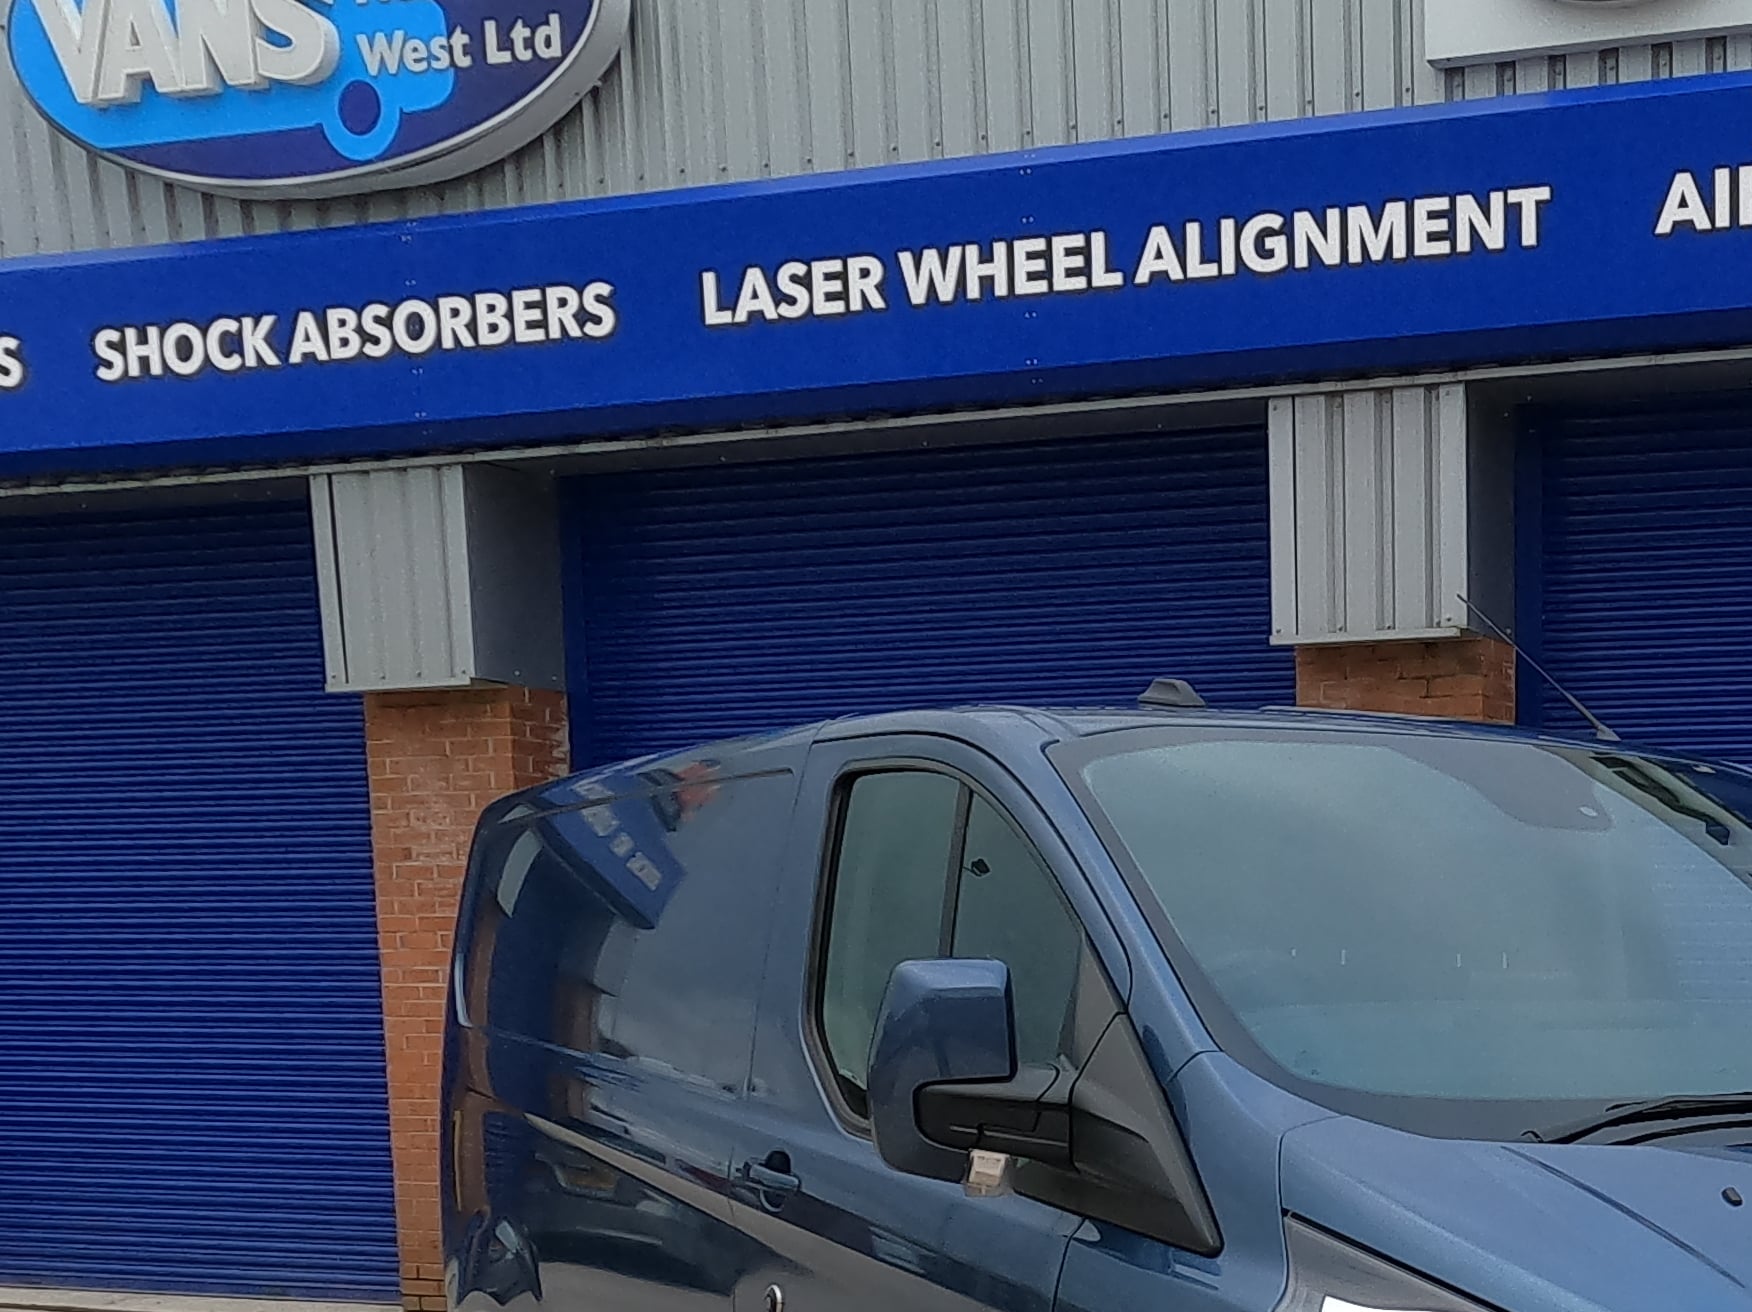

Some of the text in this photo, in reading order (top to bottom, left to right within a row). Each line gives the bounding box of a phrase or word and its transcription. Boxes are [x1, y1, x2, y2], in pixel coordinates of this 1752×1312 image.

[32, 0, 332, 105] VANS
[359, 13, 563, 76] West Ltd
[702, 185, 1551, 326] LASER WHEEL ALIGNMENT
[95, 282, 616, 382] SHOCK ABSORBERS
